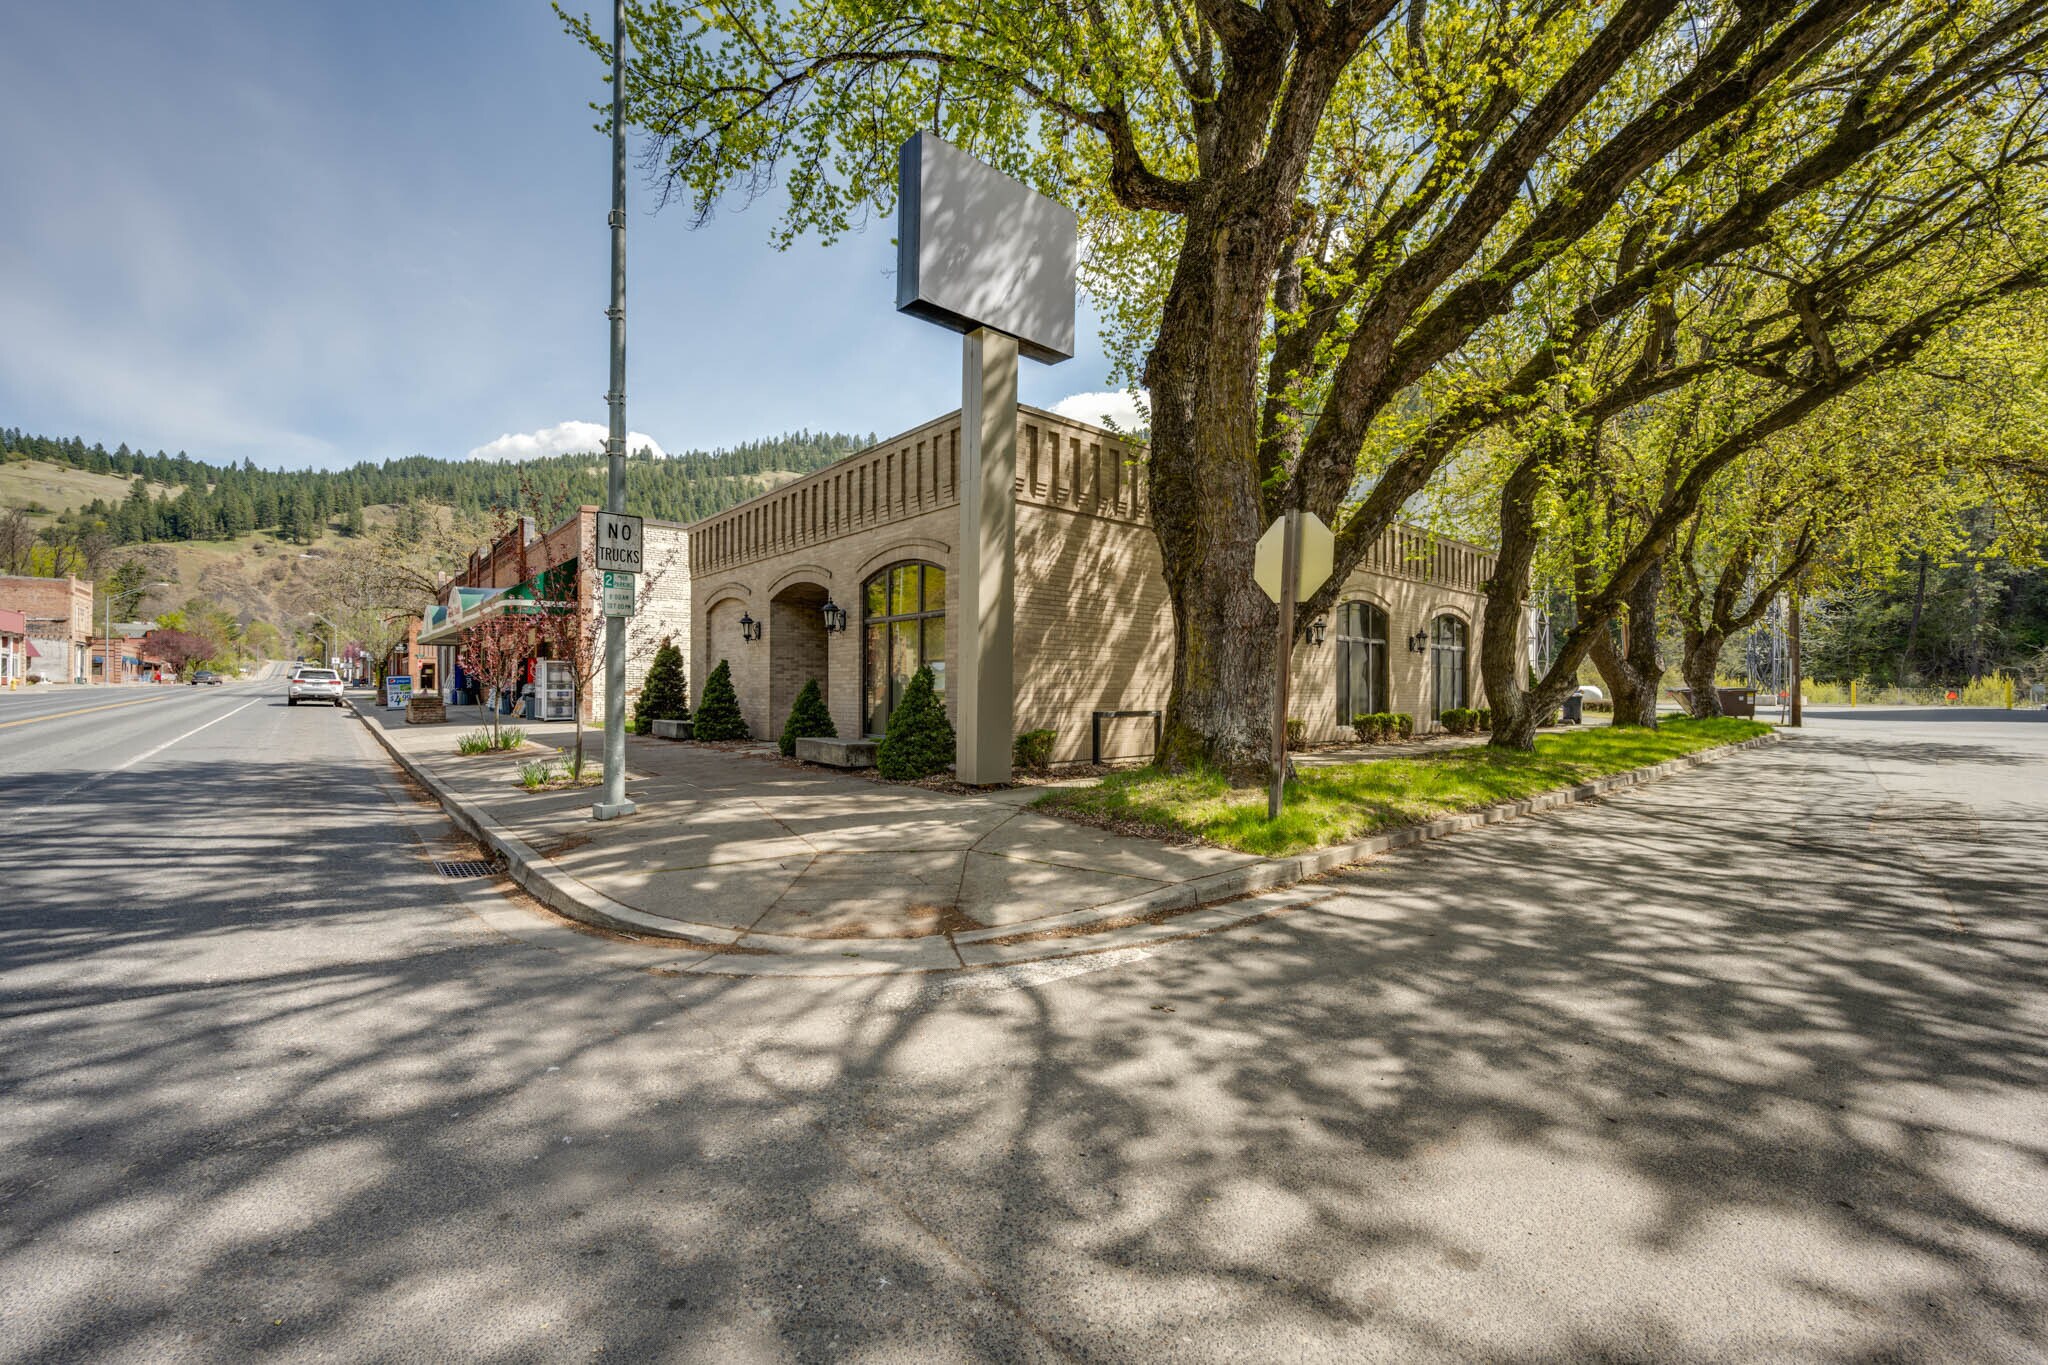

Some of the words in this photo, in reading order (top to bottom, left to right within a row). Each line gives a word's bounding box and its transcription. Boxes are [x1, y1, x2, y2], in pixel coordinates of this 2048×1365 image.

[608, 523, 632, 541] NO
[600, 546, 640, 564] TRUCKS
[605, 574, 613, 586] 2
